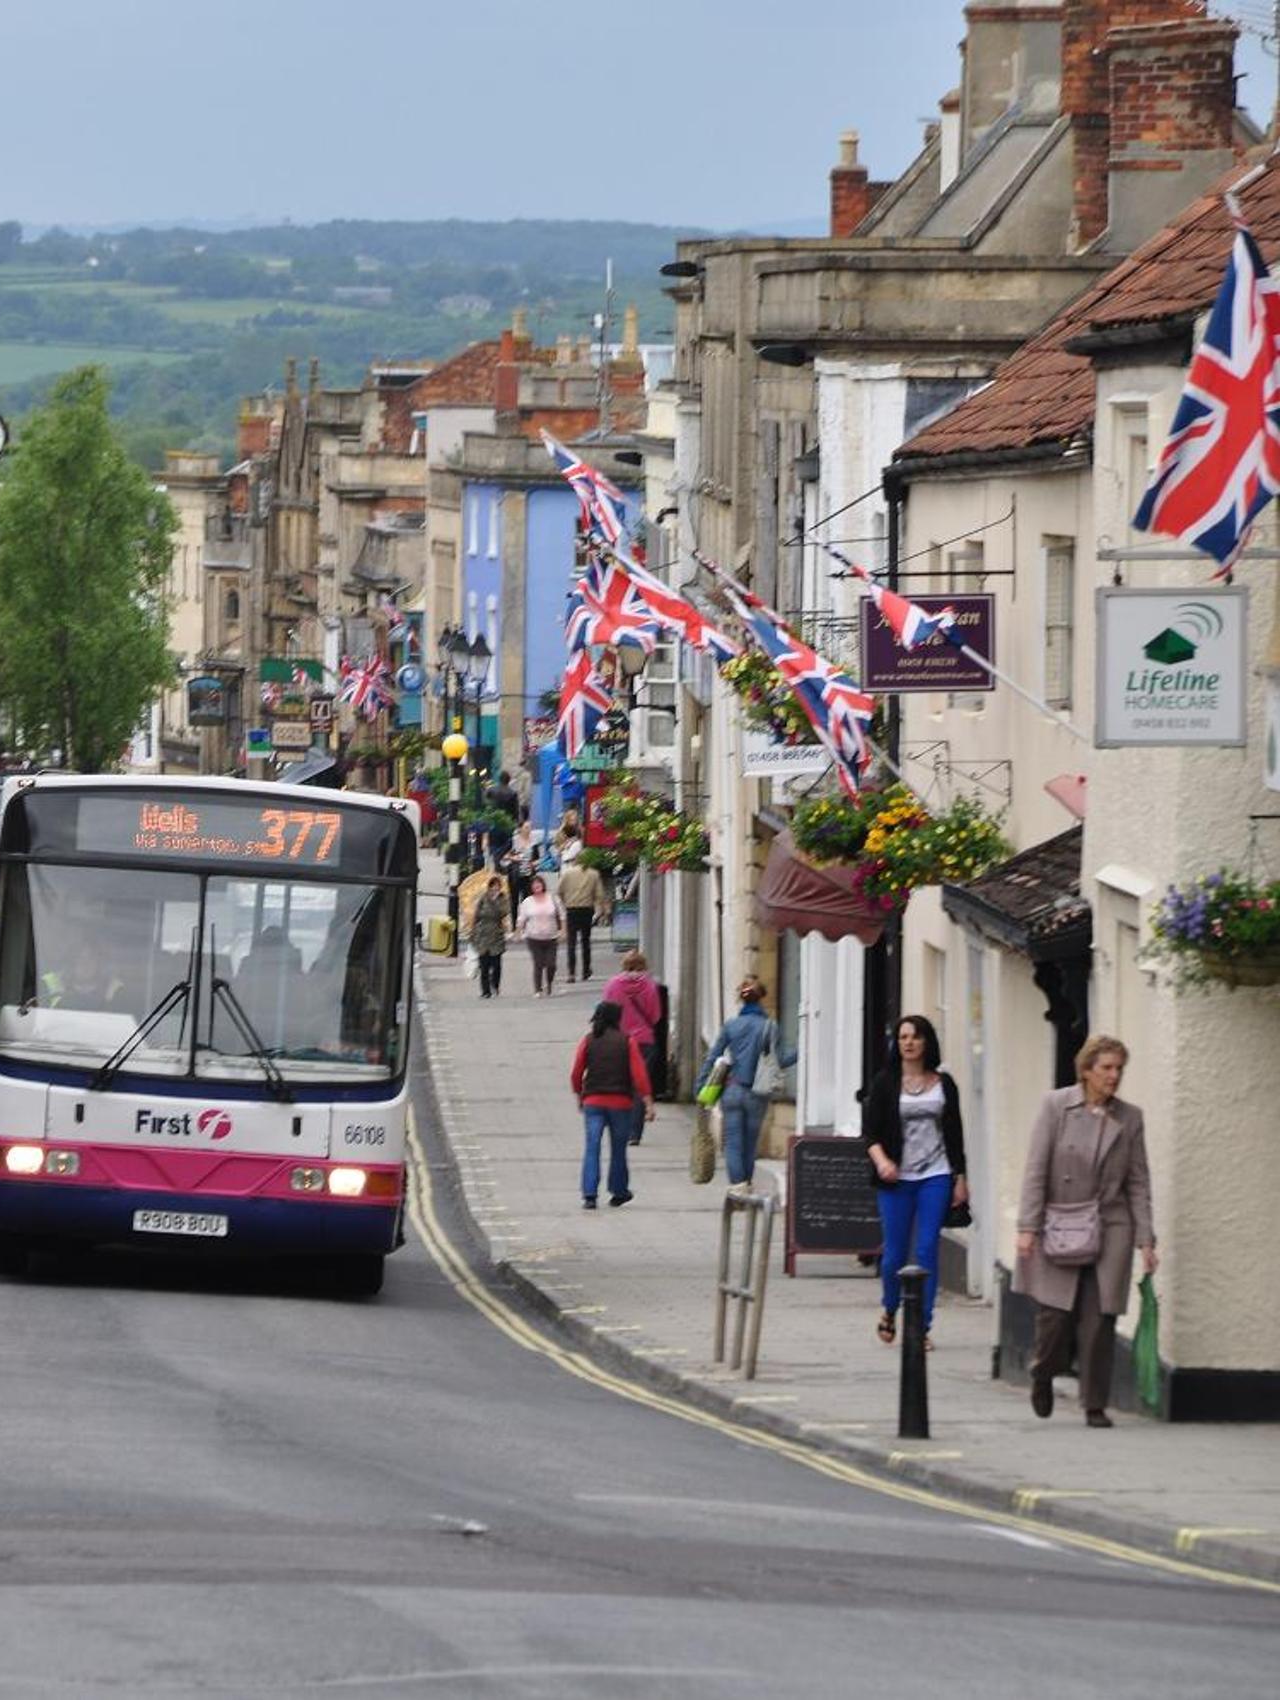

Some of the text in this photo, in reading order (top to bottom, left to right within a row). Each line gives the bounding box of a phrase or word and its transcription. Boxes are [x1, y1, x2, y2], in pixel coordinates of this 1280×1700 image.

[1126, 669, 1220, 695] Lifeline
[1124, 695, 1219, 711] HOMECARE
[140, 803, 199, 834] Wells
[261, 807, 343, 863] 377
[136, 1109, 191, 1136] First
[344, 1125, 385, 1146] 66108
